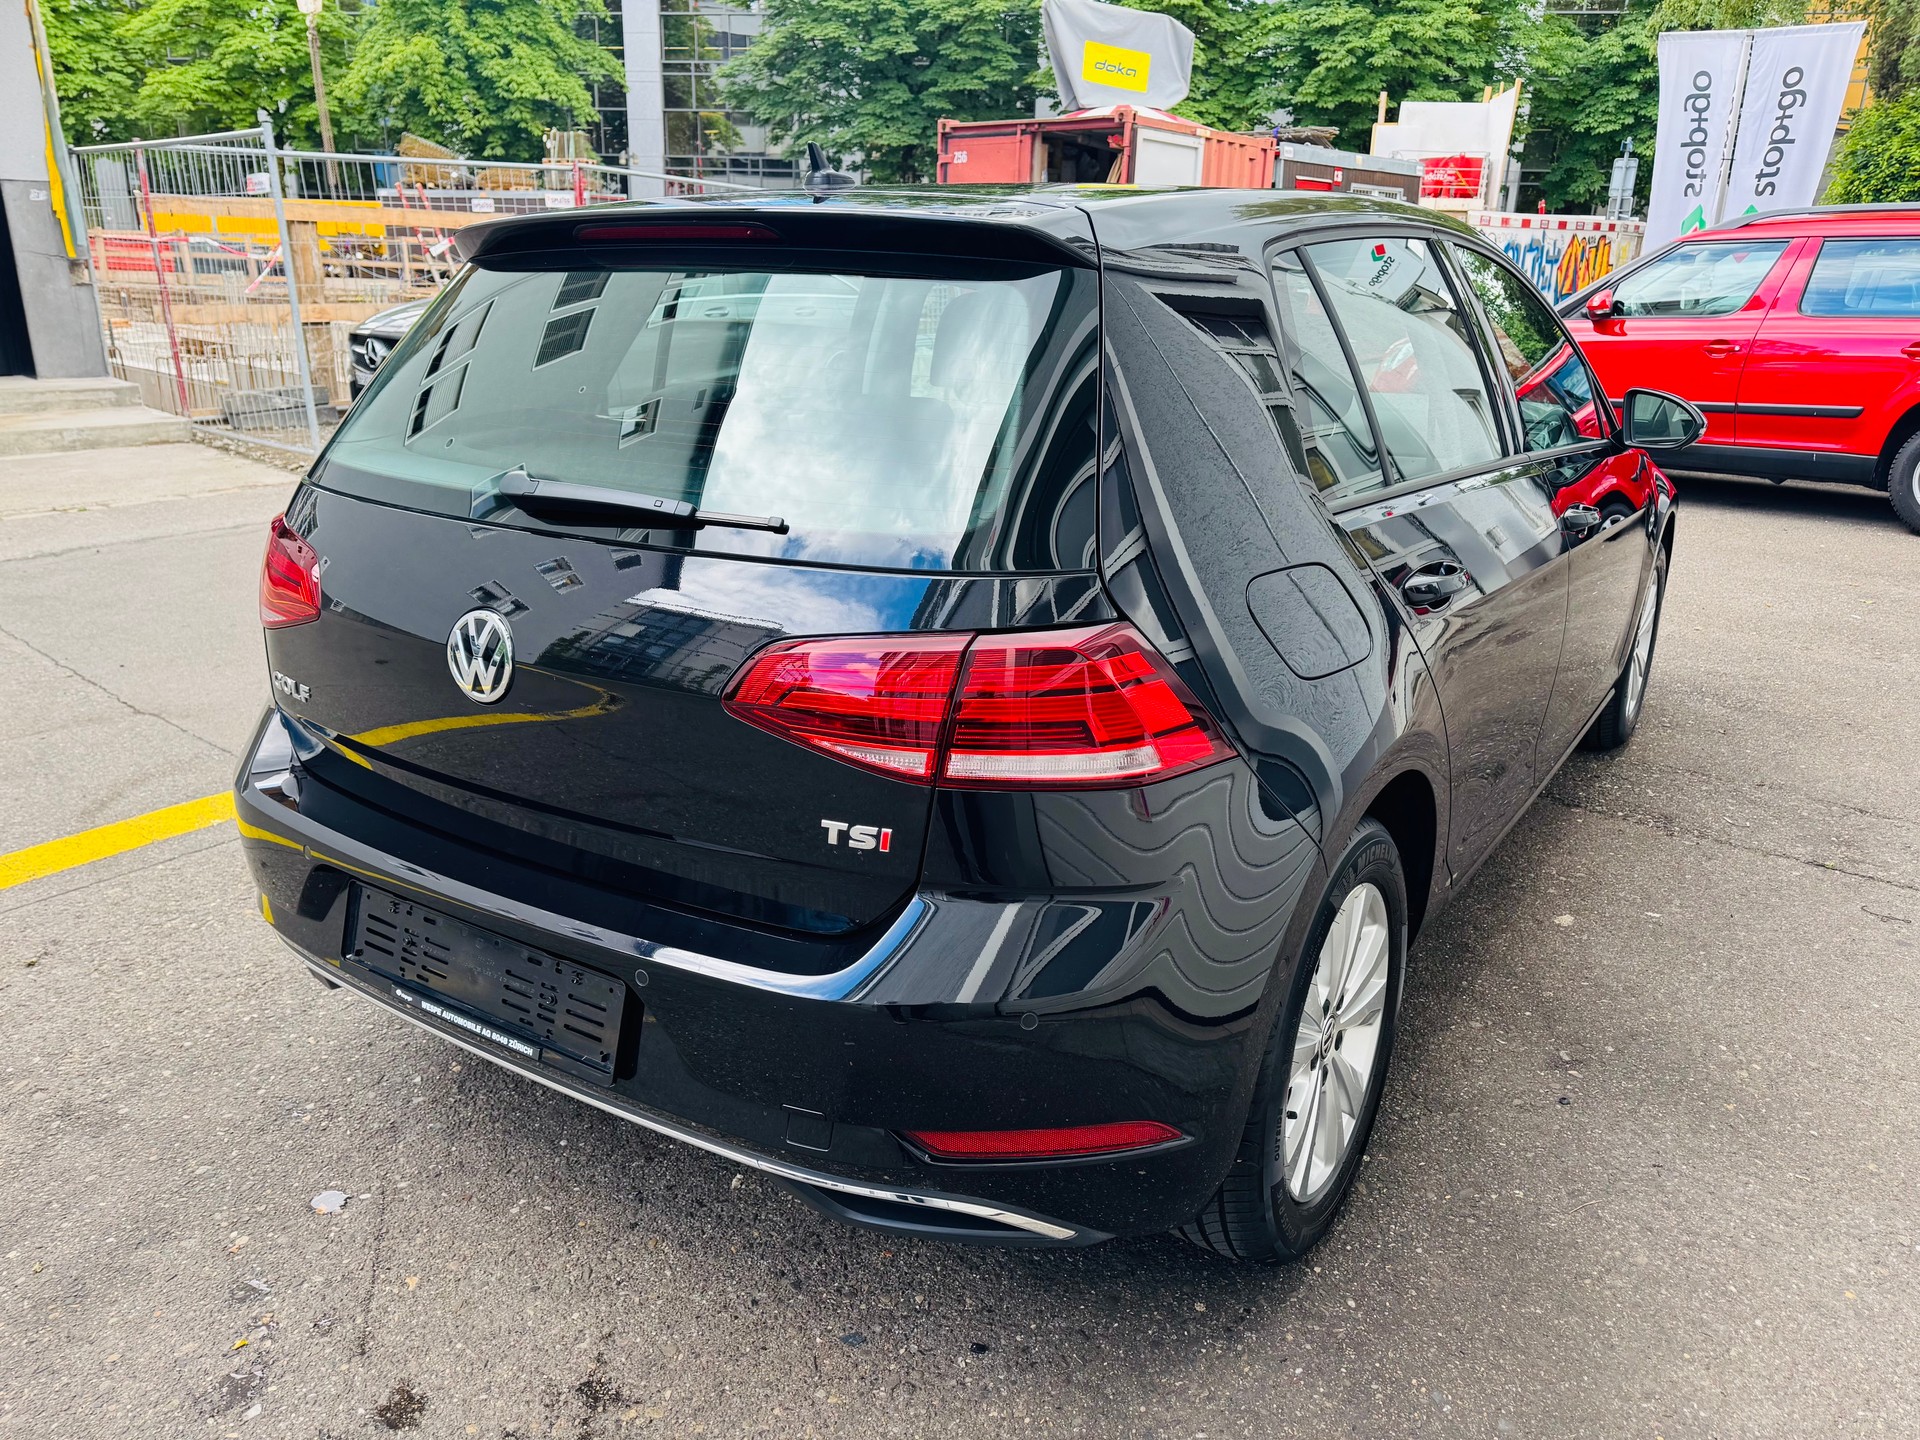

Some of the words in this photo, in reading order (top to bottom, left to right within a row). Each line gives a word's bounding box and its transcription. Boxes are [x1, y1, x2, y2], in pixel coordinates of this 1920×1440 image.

[1094, 59, 1137, 77] doka
[1754, 66, 1807, 197] stop+go
[820, 819, 893, 852] TSI
[421, 1001, 442, 1015] WESPE
[442, 1010, 482, 1033] AUTOMOBILE
[491, 1032, 507, 1044] 8048
[508, 1040, 533, 1056] ZÜRICH
